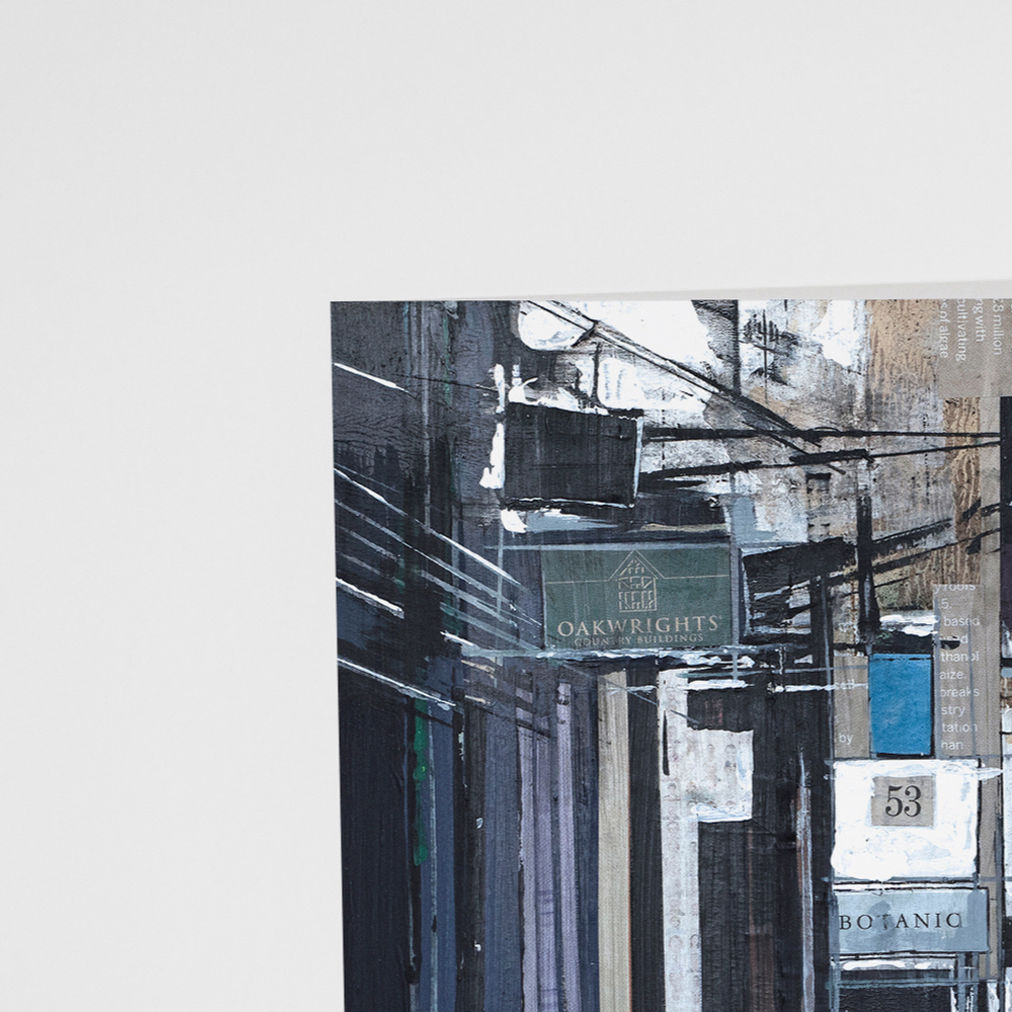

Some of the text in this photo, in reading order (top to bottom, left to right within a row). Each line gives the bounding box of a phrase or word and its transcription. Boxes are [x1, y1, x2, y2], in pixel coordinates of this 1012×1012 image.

[975, 316, 986, 342] with
[993, 315, 1004, 355] million
[557, 615, 720, 637] OAKWRIGHTS
[574, 632, 703, 647] COUNRY BUILDINGS
[941, 706, 966, 720] stry
[838, 733, 854, 746] by
[885, 785, 922, 818] 53
[839, 912, 962, 931] BOTANIC
